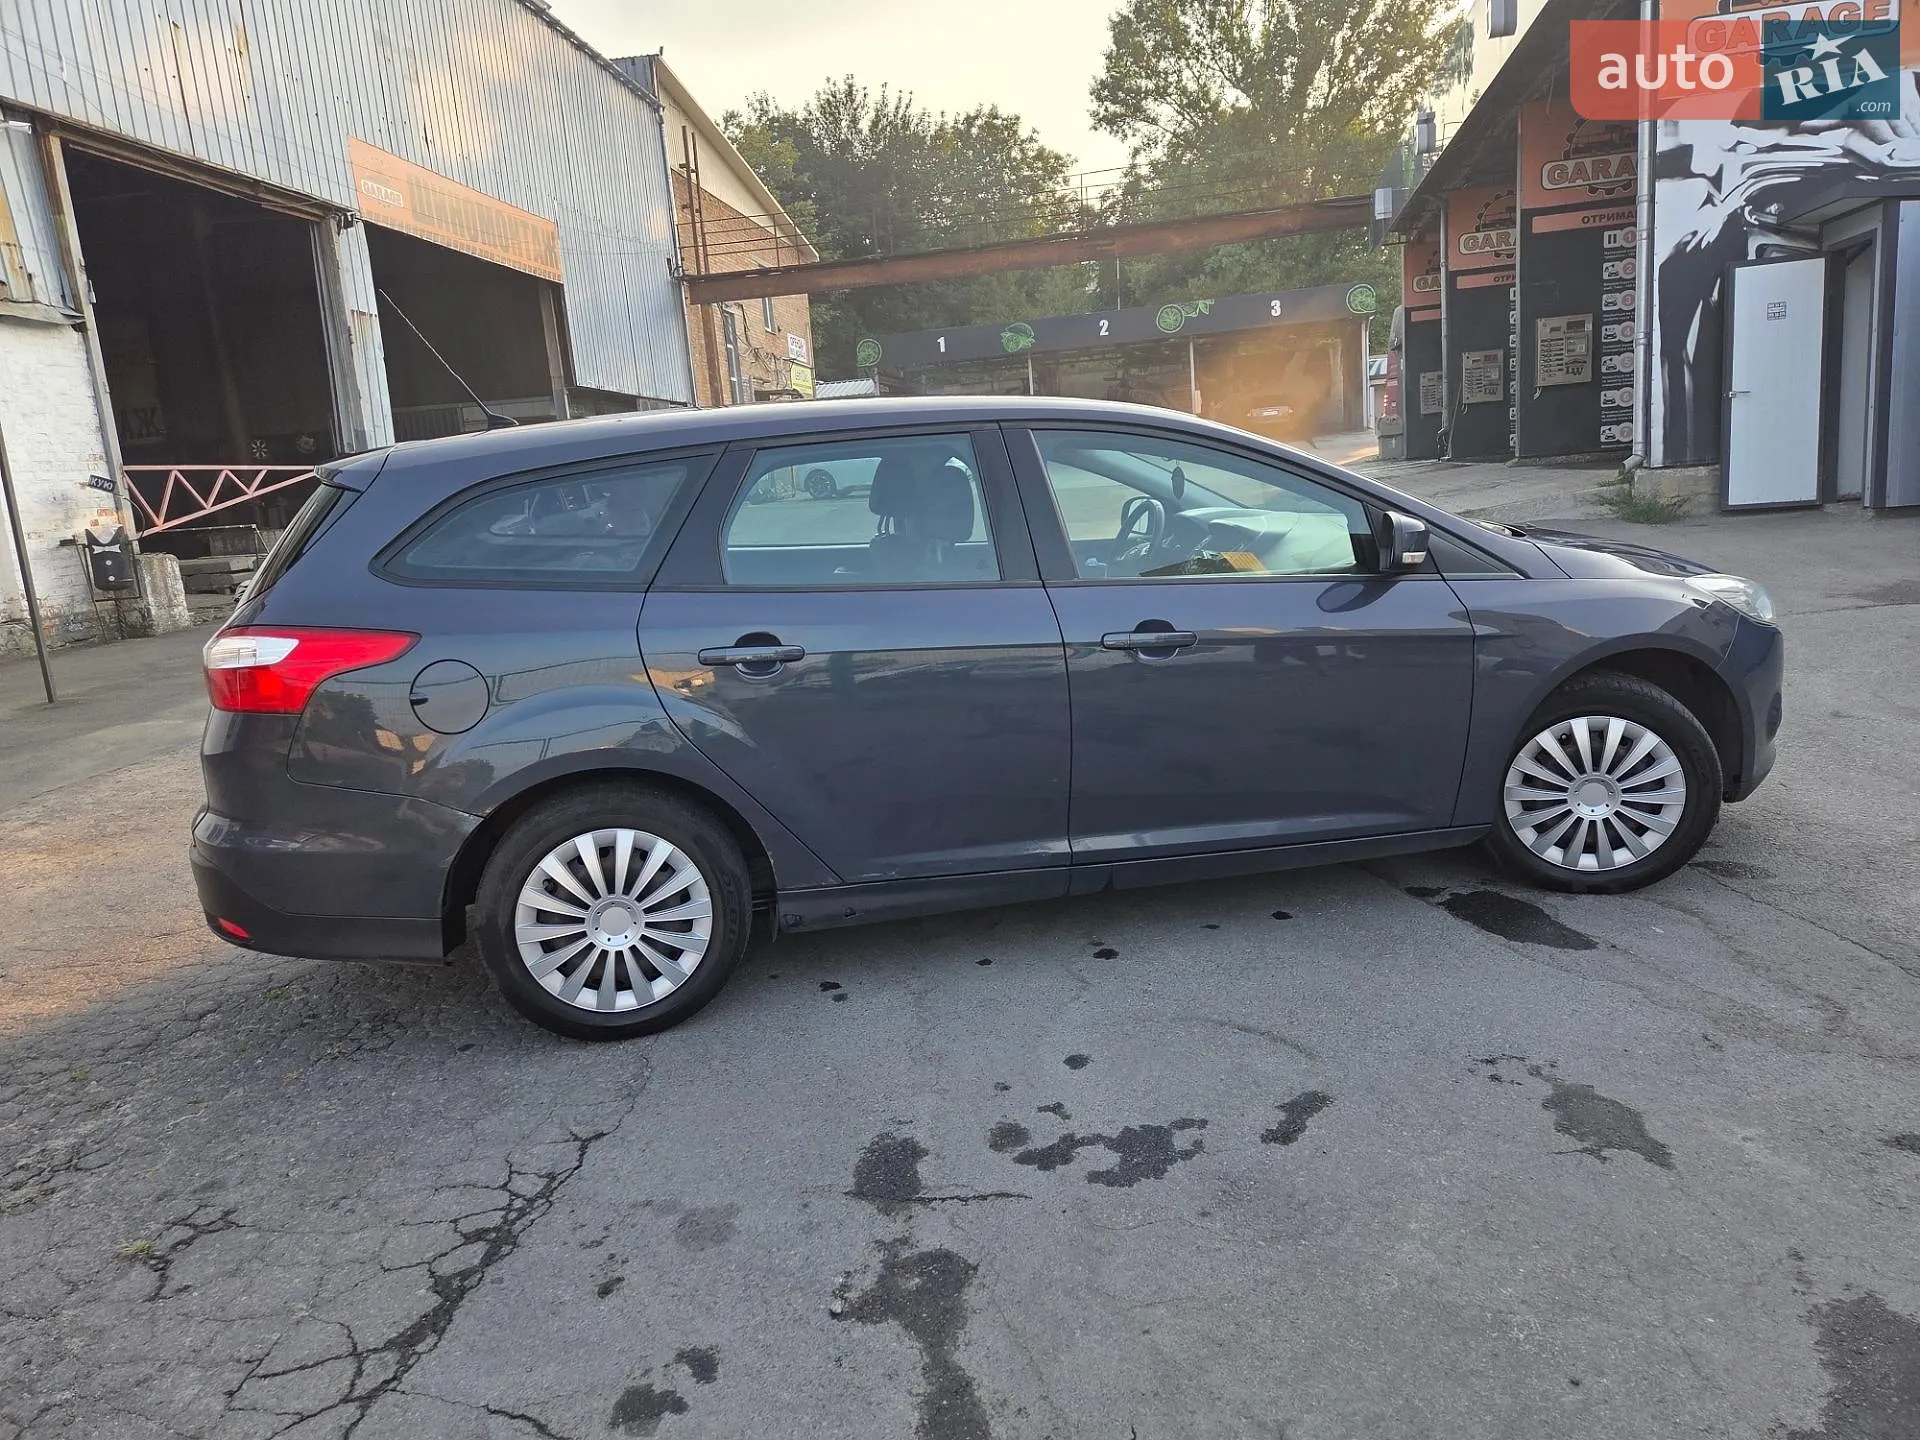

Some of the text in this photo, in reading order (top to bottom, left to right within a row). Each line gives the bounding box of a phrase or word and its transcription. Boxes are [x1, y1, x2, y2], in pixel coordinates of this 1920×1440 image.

[1694, 0, 1892, 51] GARAGE
[1271, 299, 1282, 317] 3
[1099, 319, 1110, 336] 2
[936, 336, 946, 353] 1
